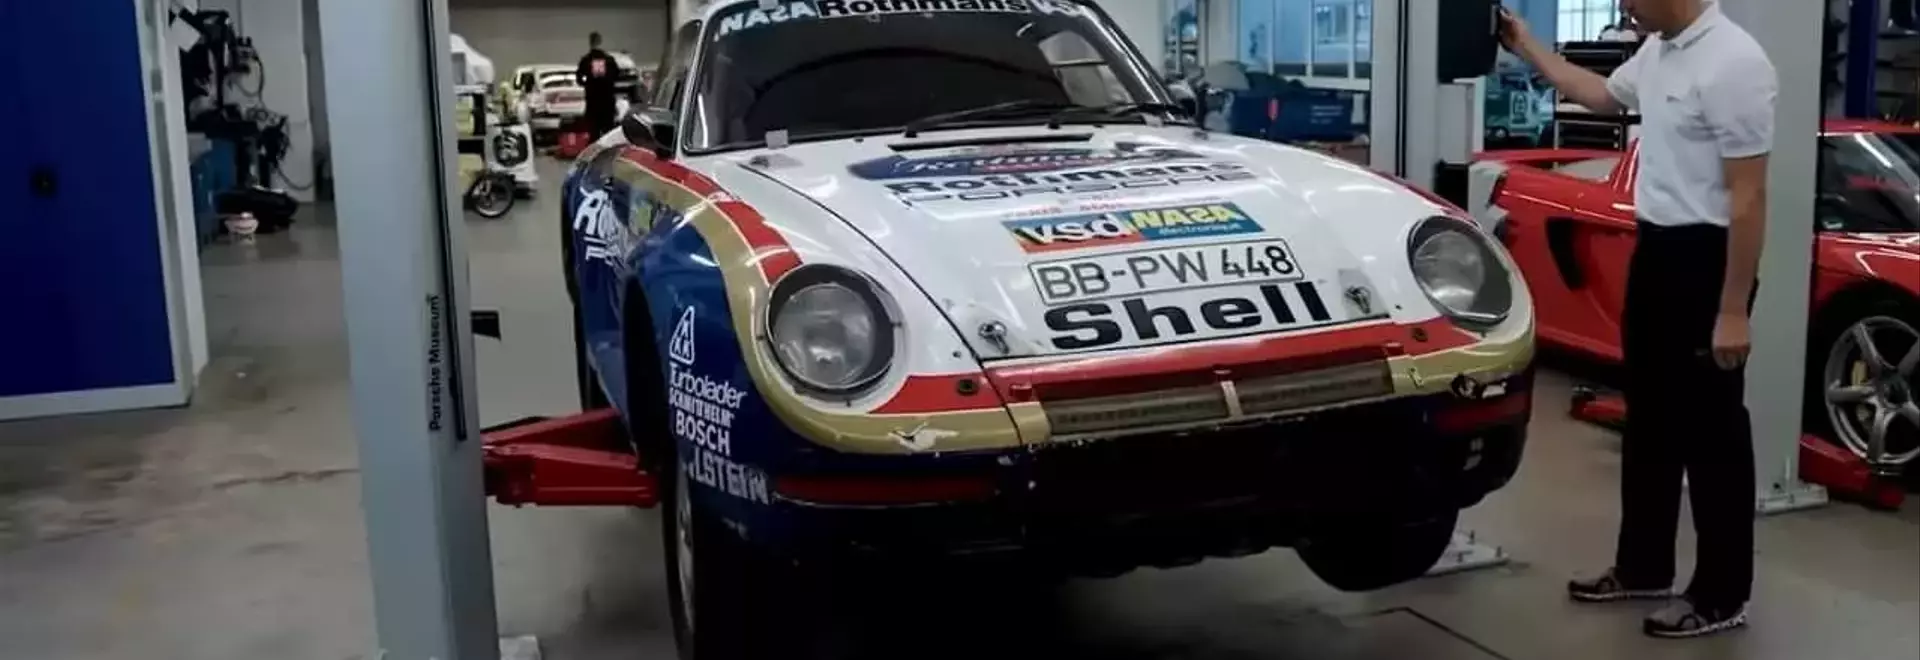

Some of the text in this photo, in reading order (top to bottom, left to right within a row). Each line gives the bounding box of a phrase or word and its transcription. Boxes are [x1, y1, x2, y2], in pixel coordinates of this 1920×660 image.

[820, 0, 1029, 16] Rothmans
[1037, 245, 1294, 298] BB-PW 448
[1043, 281, 1332, 350] Shell
[669, 361, 747, 408] Turbolader
[675, 409, 731, 456] BOSCH
